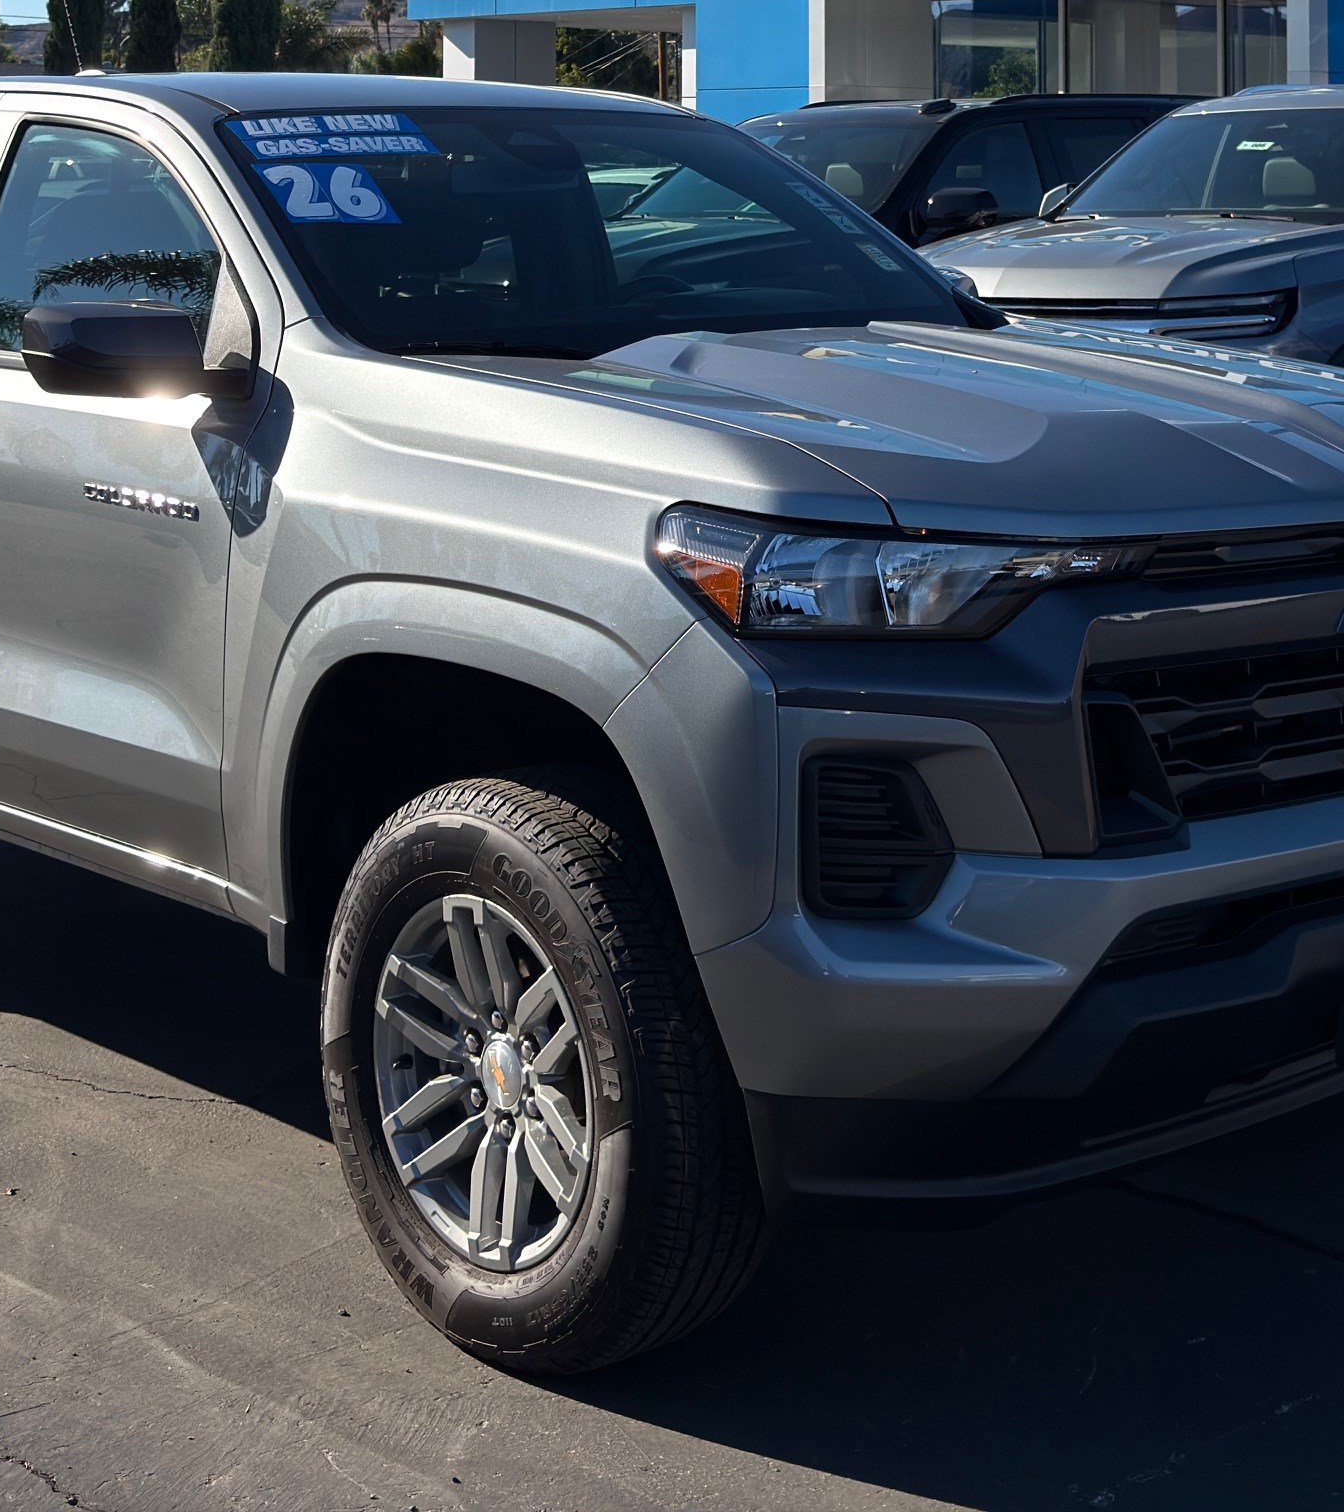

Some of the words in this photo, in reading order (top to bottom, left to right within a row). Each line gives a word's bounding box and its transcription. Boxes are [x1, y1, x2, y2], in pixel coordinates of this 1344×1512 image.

[242, 115, 321, 137] LIKE
[323, 113, 400, 133] NEW
[256, 135, 427, 156] GAS-SAVER
[262, 164, 387, 221] 26
[328, 1068, 435, 1311] WRANGLER
